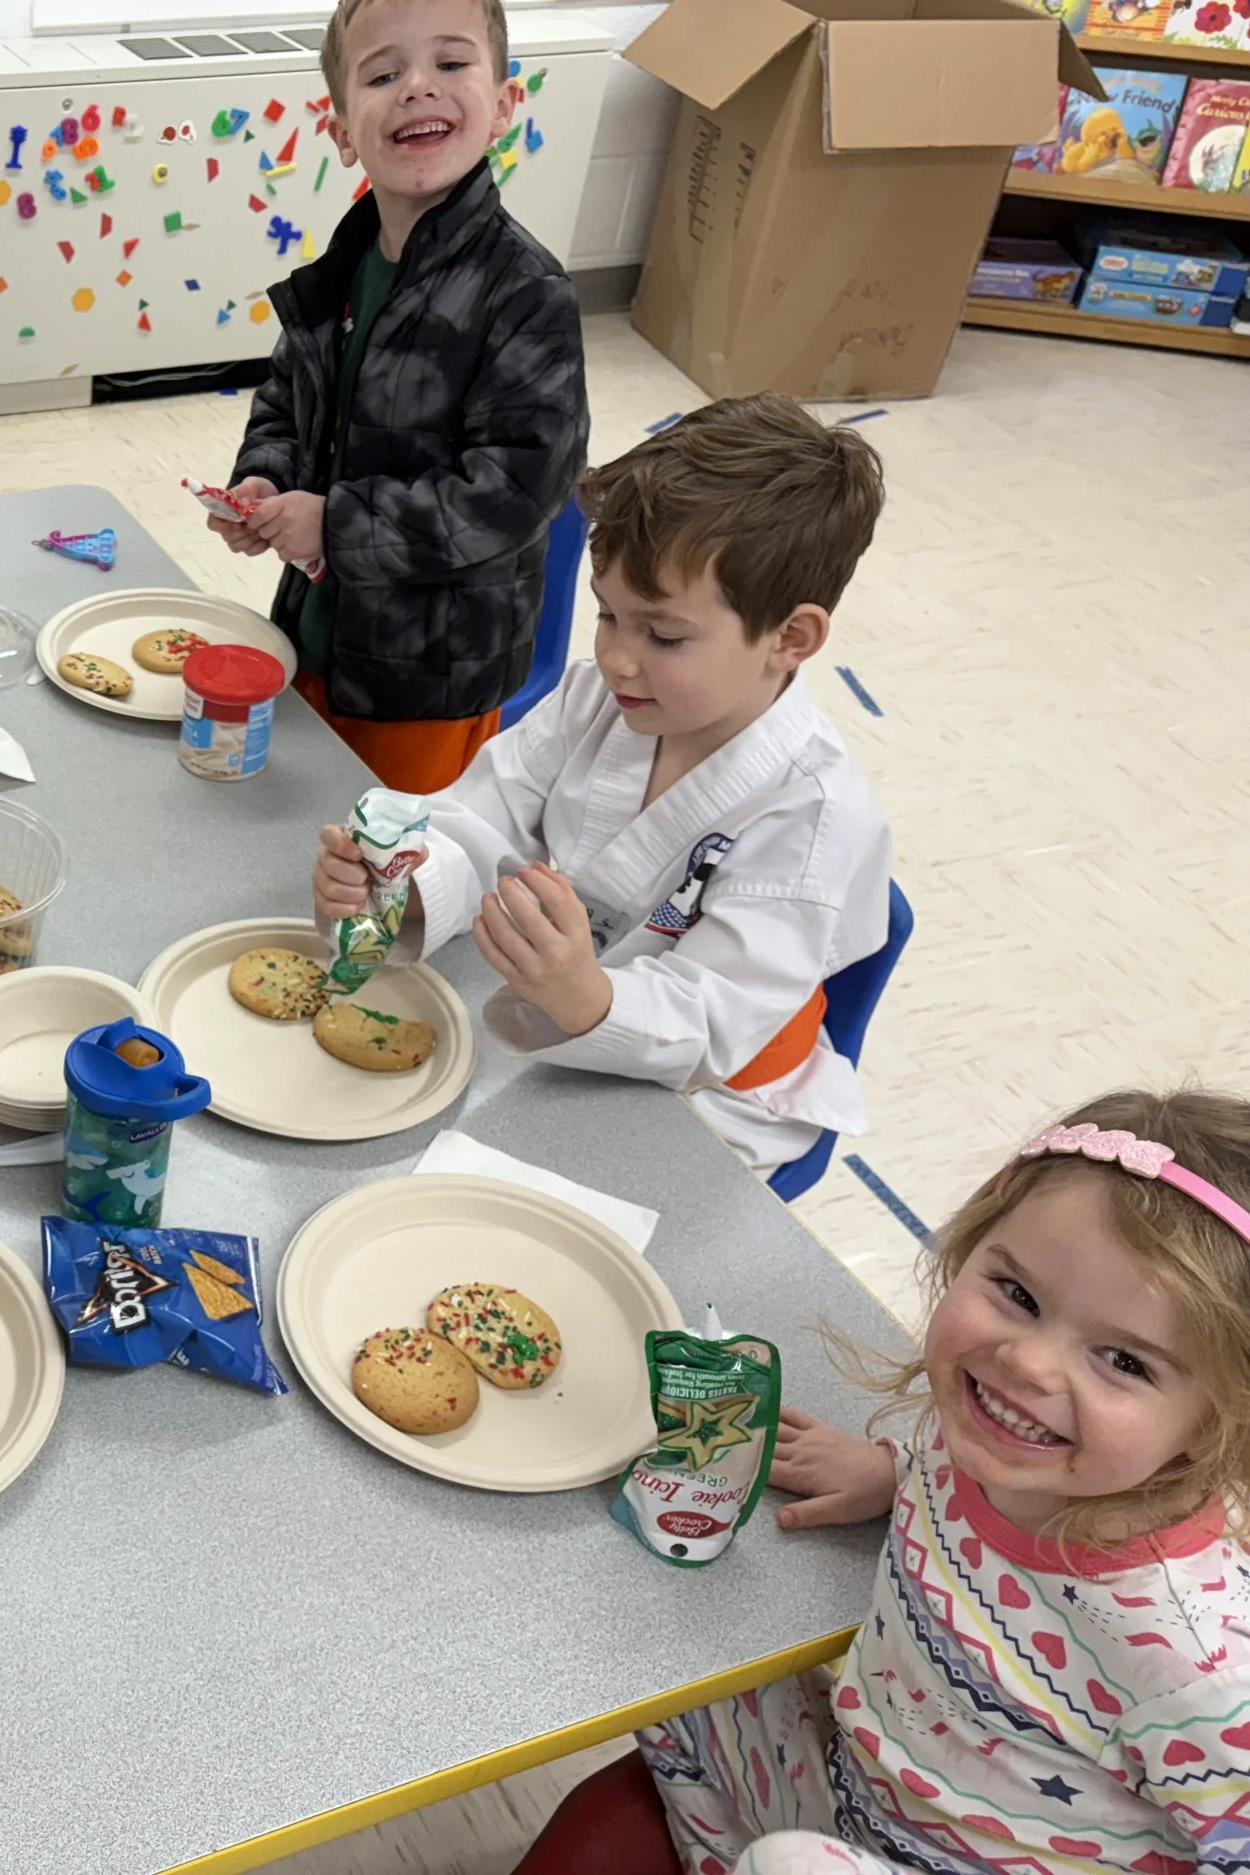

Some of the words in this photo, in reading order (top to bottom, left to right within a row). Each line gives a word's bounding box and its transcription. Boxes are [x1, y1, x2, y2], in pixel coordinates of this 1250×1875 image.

[1121, 90, 1176, 113] Friend
[1196, 103, 1244, 120] Curious
[684, 1372, 696, 1380] for
[696, 1373, 727, 1381] Smooth
[708, 1386, 738, 1398] TASTES
[665, 1514, 712, 1531] Crocker
[669, 1521, 701, 1537] Betty
